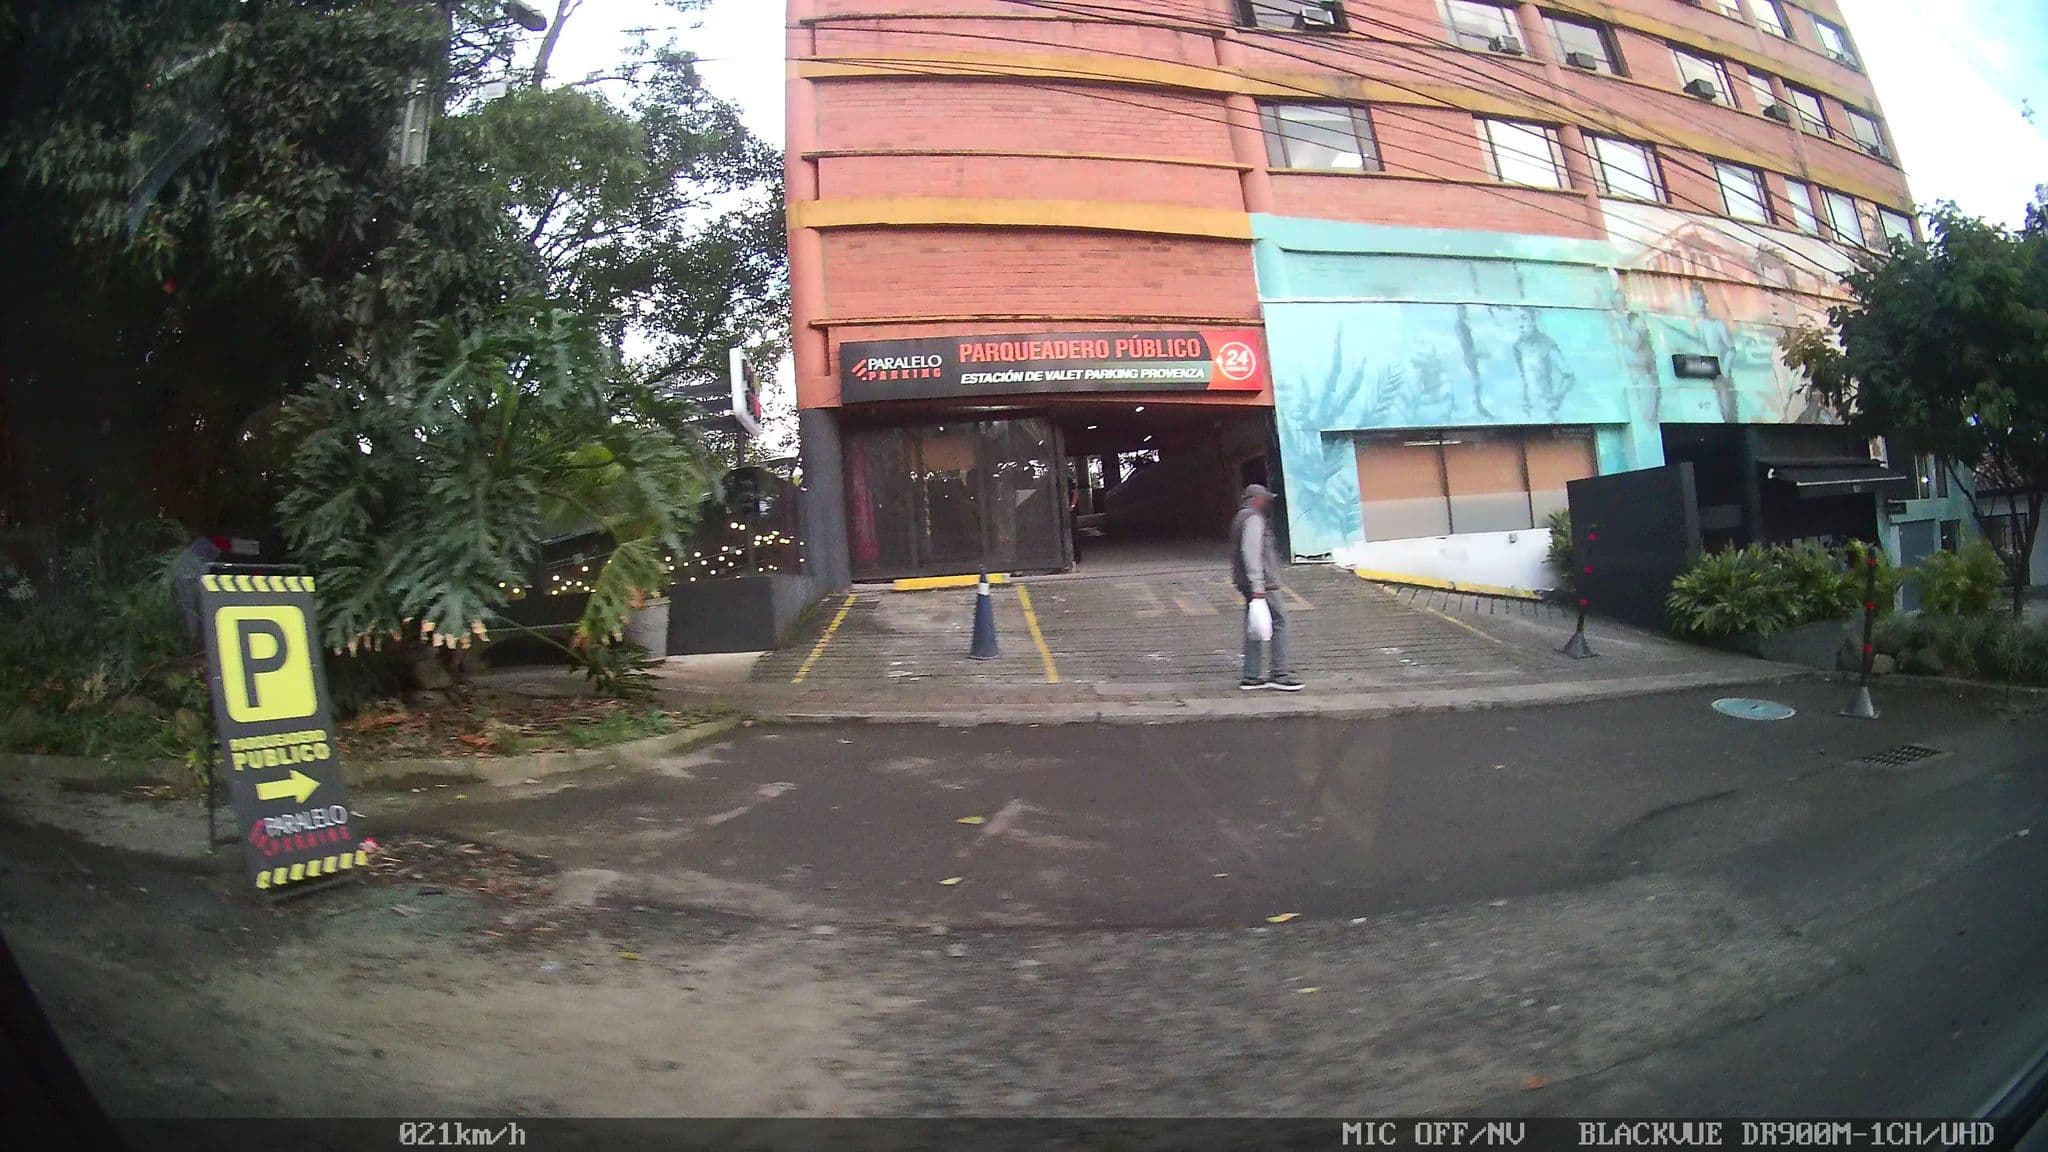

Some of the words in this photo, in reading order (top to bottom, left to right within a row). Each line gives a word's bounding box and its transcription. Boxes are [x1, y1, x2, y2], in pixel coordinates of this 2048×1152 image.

[959, 339, 1110, 363] PARQUEADERO
[1116, 335, 1201, 359] PÚBLICO
[1226, 349, 1249, 366] 24
[867, 354, 943, 371] PARALELO
[960, 369, 1025, 385] ESTACIÓN
[1025, 371, 1043, 382] DE
[1045, 369, 1084, 381] VALET
[1084, 367, 1139, 380] PARKING
[1140, 367, 1206, 379] PROVENZA
[237, 619, 289, 708] P
